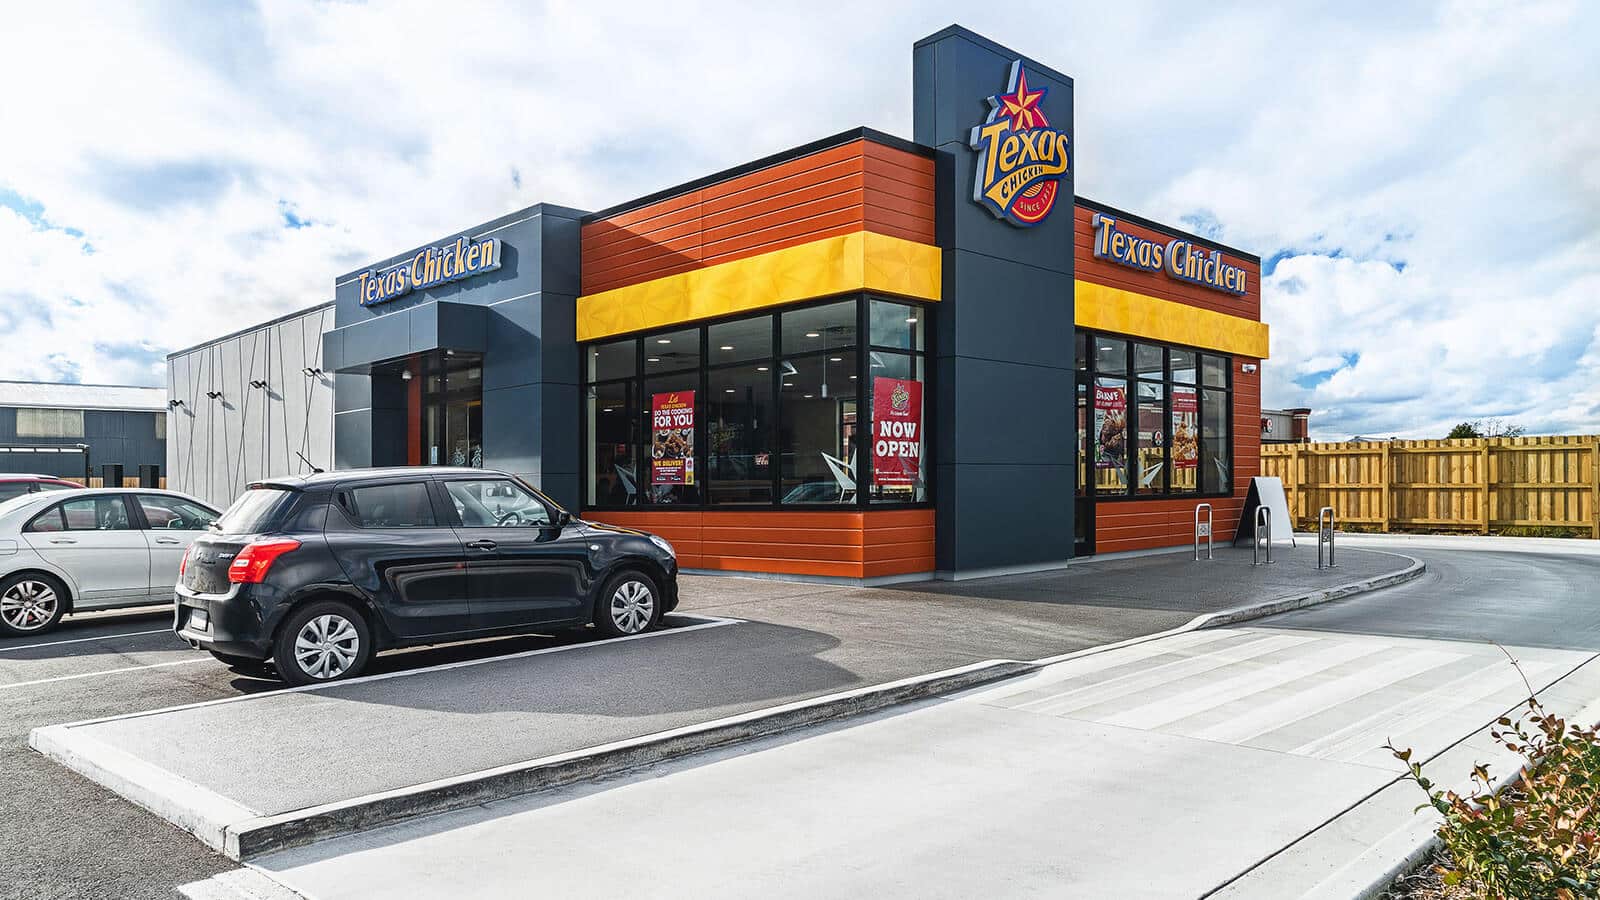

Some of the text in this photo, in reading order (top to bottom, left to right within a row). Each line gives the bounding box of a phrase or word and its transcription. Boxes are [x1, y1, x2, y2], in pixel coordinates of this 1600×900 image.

[982, 119, 1068, 189] Texas
[1001, 166, 1044, 199] CHICKEN
[1019, 201, 1041, 213] SINCE
[1099, 216, 1246, 292] Texas Chicken
[359, 237, 494, 305] Texas Chicken
[655, 414, 693, 427] FOR YOU
[880, 421, 917, 438] NOW
[876, 440, 920, 457] OPEN
